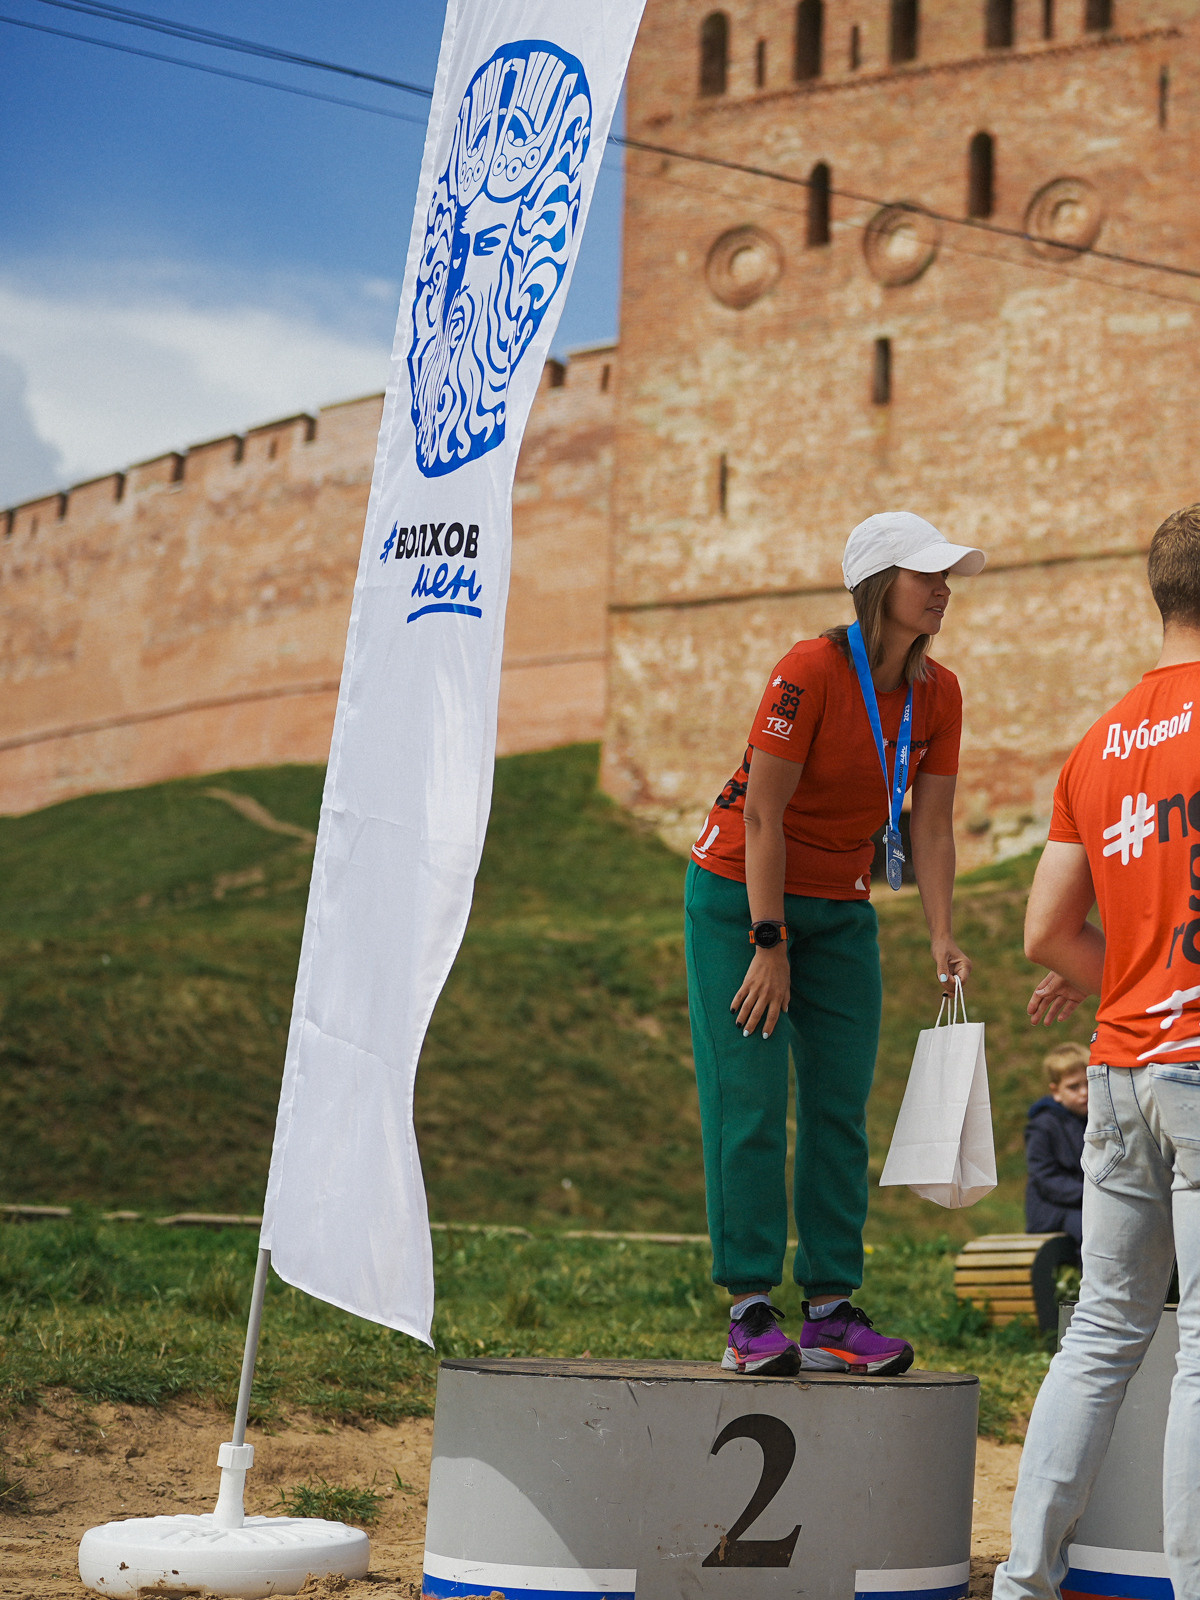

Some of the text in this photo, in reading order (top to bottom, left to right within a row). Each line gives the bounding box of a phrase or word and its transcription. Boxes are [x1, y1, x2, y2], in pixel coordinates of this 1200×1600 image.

[380, 520, 480, 565] #ВОЛХОВ
[411, 562, 482, 602] мен
[772, 675, 806, 697] #nov
[780, 693, 800, 707] go
[766, 716, 794, 735] TRI
[771, 703, 798, 721] rod
[1102, 702, 1193, 760] Дубовой
[702, 1413, 802, 1569] 2
